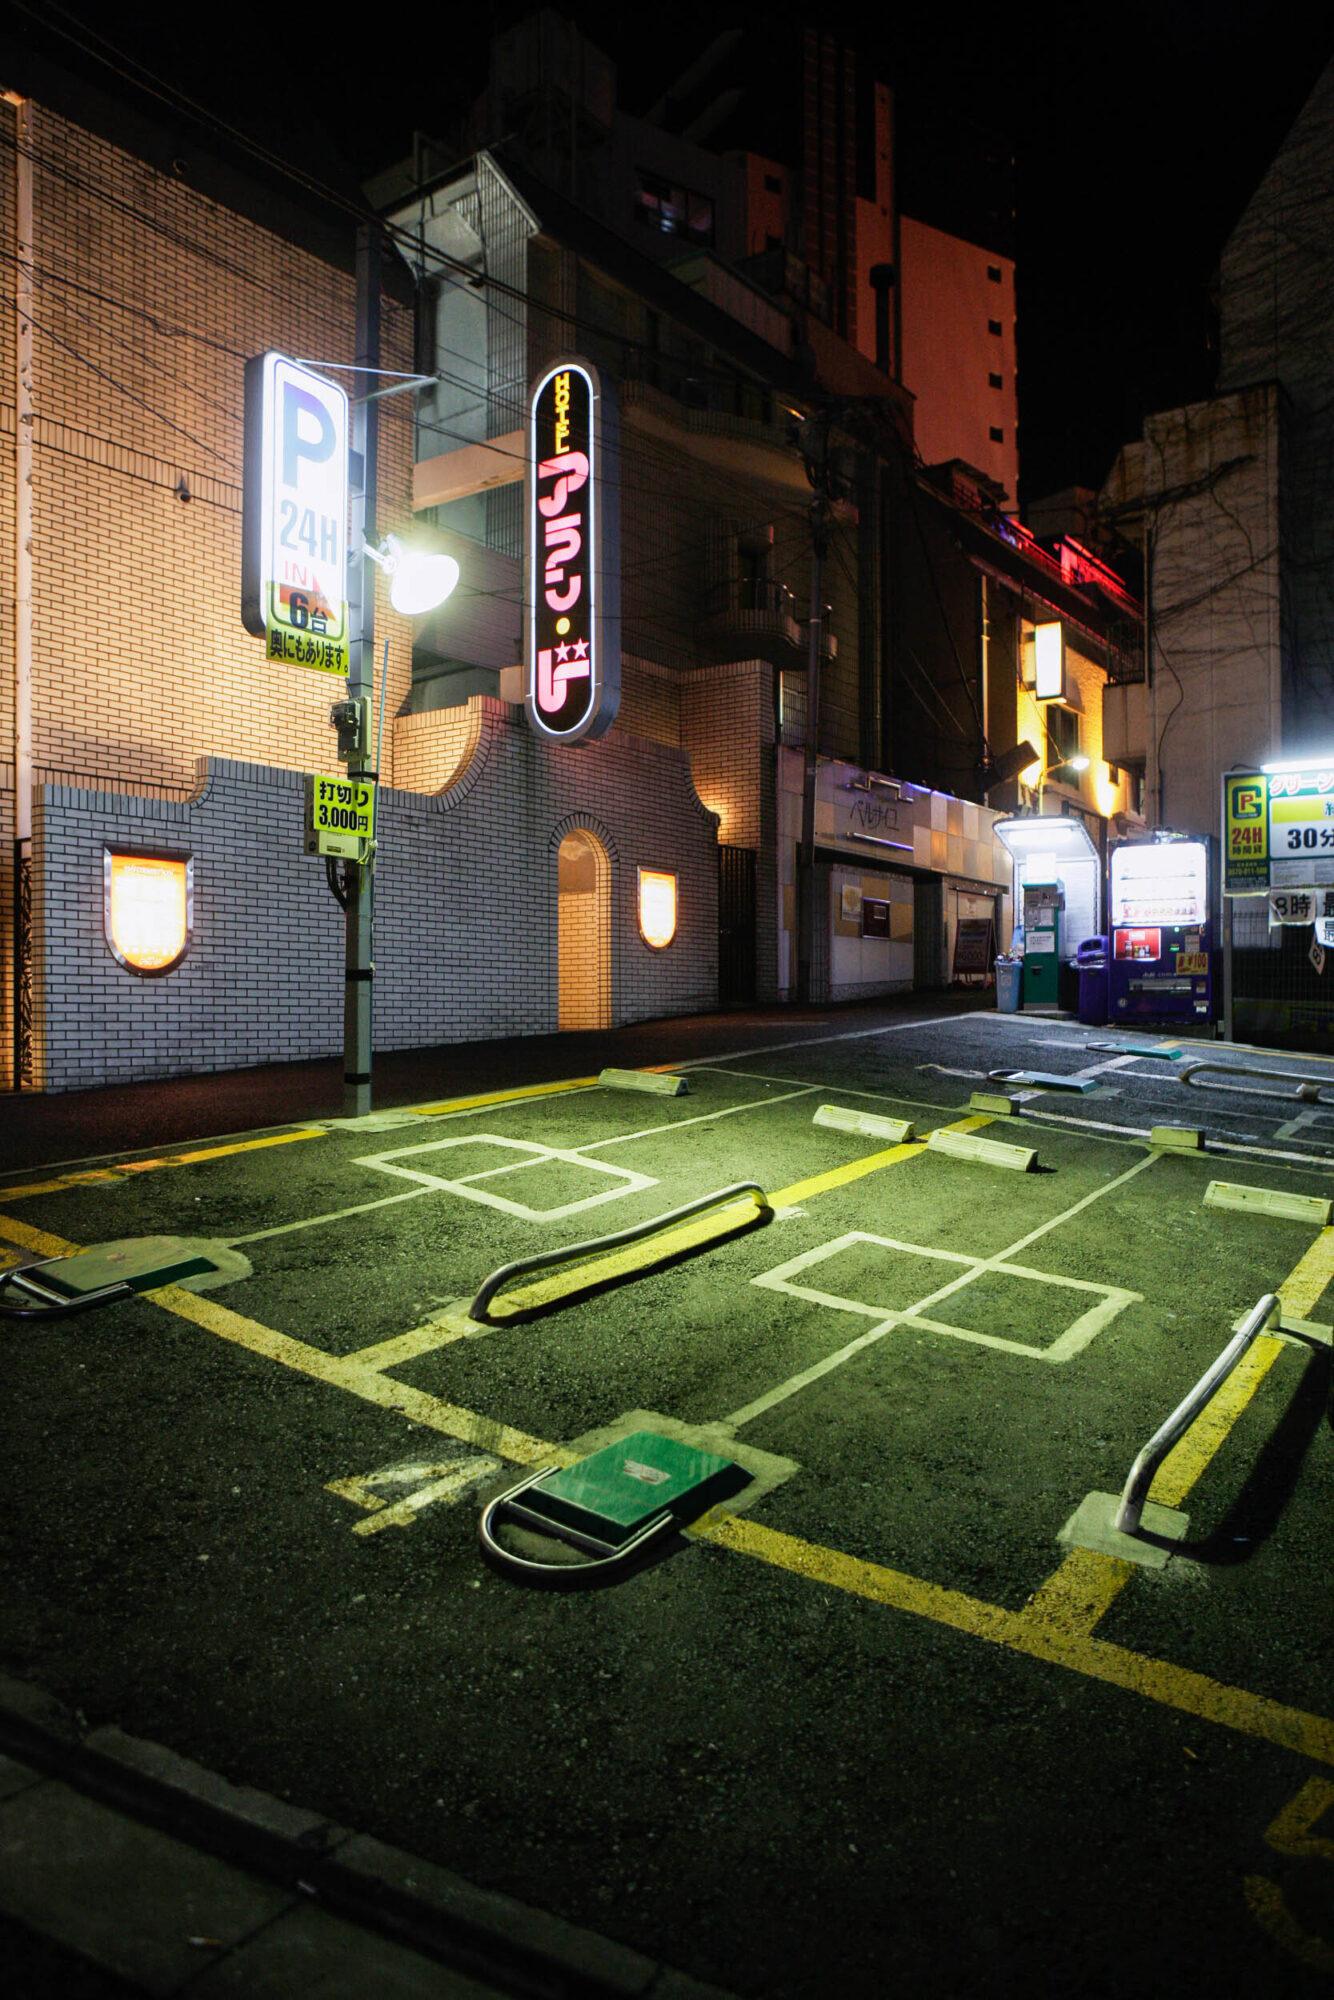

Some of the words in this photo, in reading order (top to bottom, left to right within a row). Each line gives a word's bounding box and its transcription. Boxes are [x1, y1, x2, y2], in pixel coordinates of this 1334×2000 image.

[282, 380, 337, 489] P
[554, 372, 571, 455] HOTEL
[280, 498, 338, 566] 24H
[284, 560, 308, 587] IN
[289, 592, 328, 634] 6台
[270, 629, 349, 673] 奥にもあります。
[319, 781, 369, 808] 打切り
[318, 804, 369, 832] 3,000円
[1232, 827, 1262, 845] 24H
